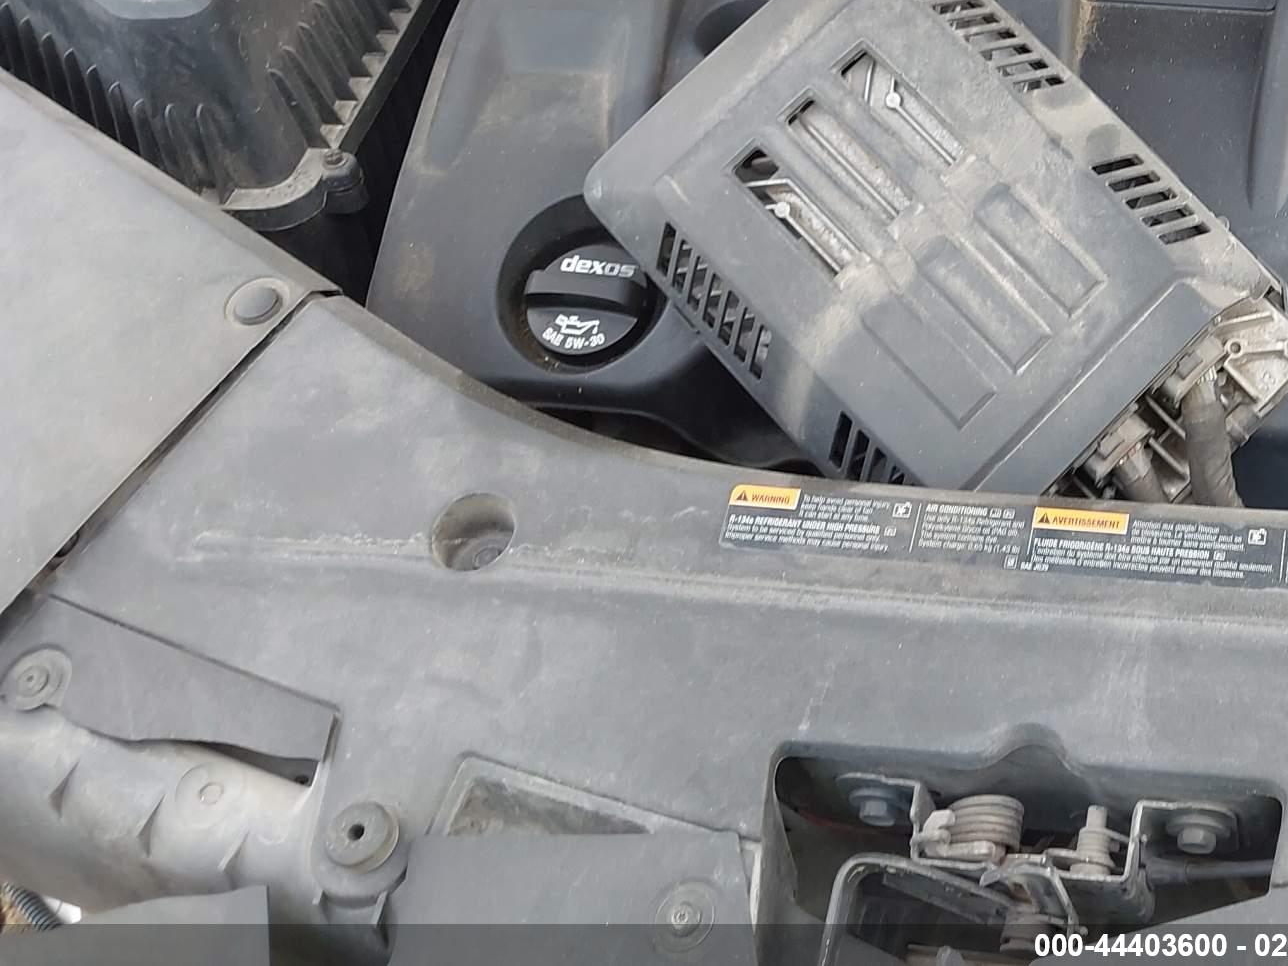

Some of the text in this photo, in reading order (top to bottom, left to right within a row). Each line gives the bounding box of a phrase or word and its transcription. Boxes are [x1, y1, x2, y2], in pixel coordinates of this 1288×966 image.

[560, 255, 637, 278] dexos
[752, 494, 790, 504] WARNING
[926, 503, 987, 516] AIR CONDITIONING
[754, 516, 802, 528] REFRIGERANT
[802, 520, 826, 531] UNDER
[826, 522, 843, 532] HIGH
[844, 524, 880, 535] PRESSURE
[1052, 516, 1119, 529] AVERTISSEMENT
[1034, 537, 1058, 547] FLUIDE
[1131, 545, 1150, 554] SOUS
[1150, 546, 1174, 556] HAUTE
[1175, 548, 1209, 559] PRESSION
